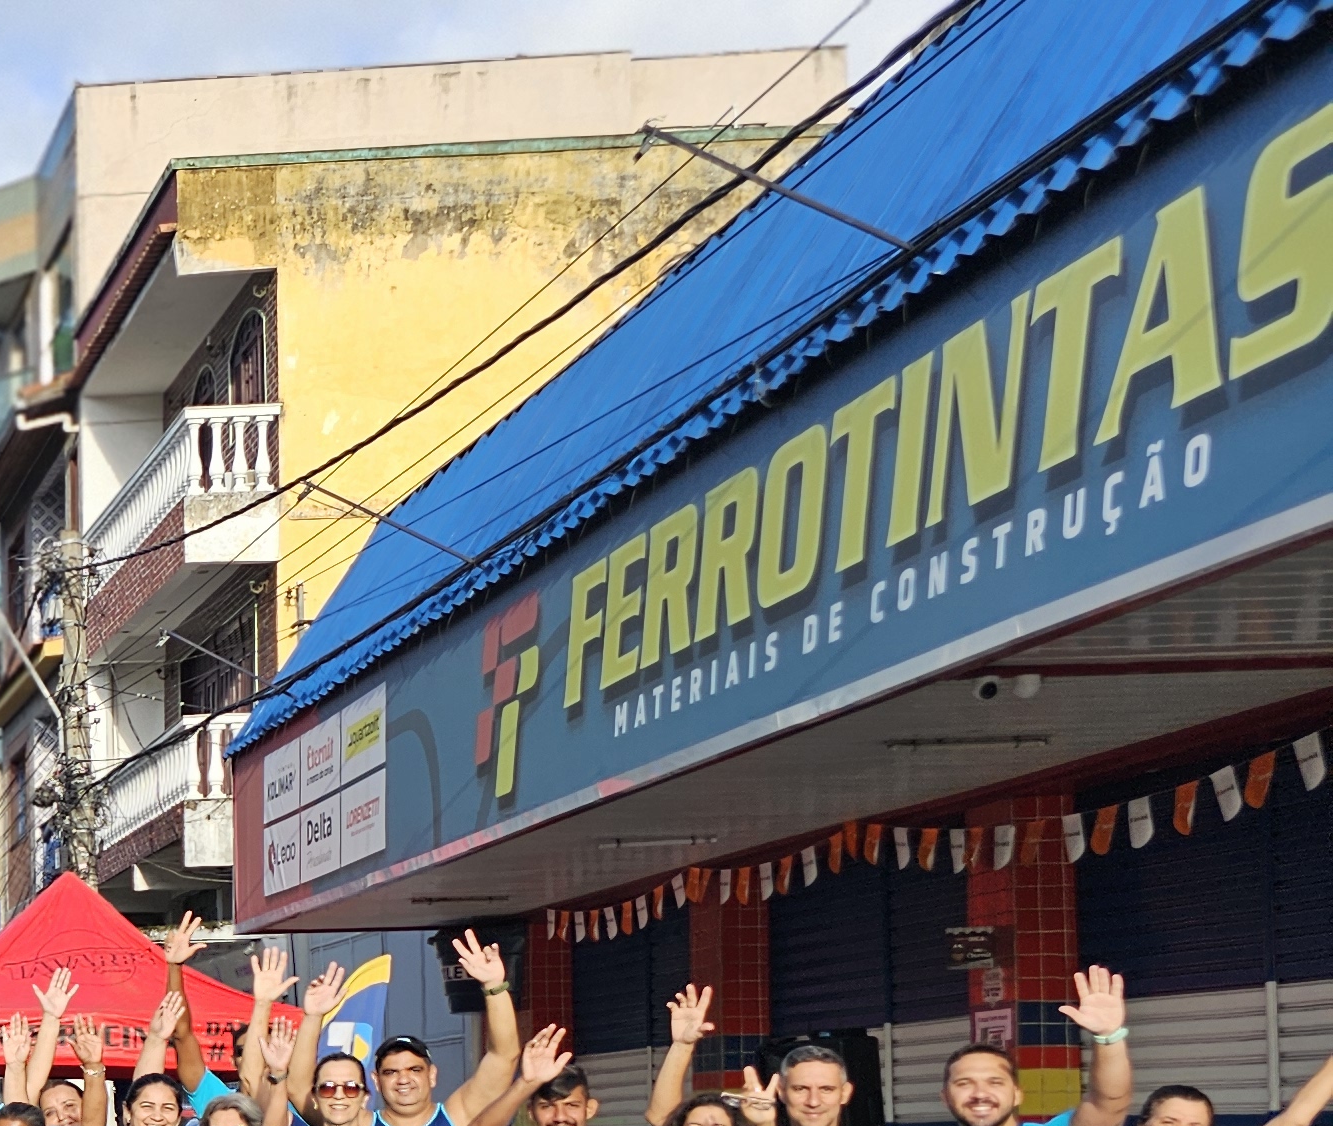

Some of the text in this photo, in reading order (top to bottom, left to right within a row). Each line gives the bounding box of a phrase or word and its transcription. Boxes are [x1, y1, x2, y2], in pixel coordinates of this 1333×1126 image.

[563, 102, 1333, 709] FERROTINTAS
[614, 432, 1212, 738] MATERIAIS DE CONSTRUÇÃO
[307, 812, 333, 846] Delta
[346, 796, 380, 829] LORENZETTI
